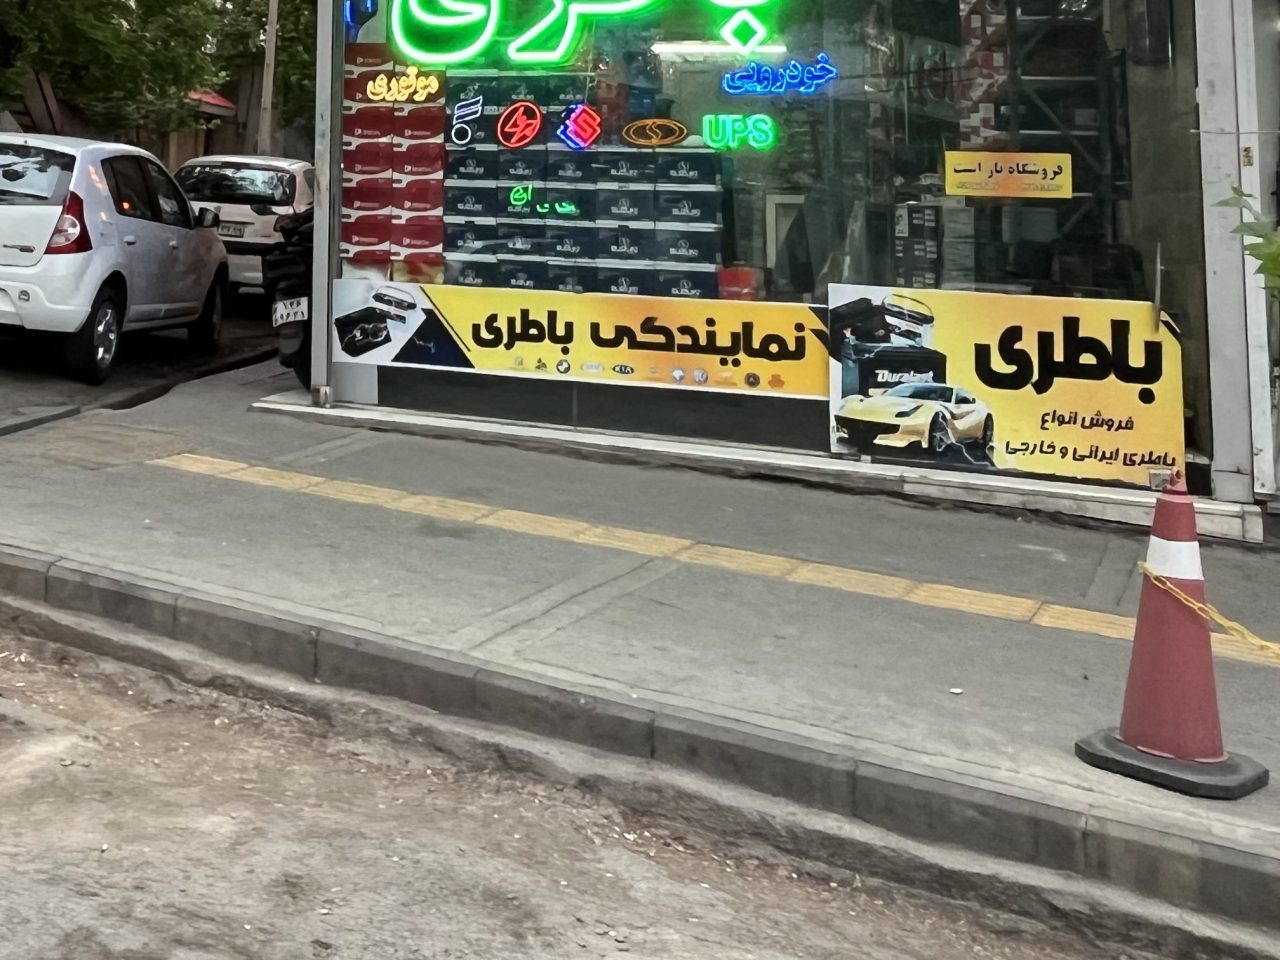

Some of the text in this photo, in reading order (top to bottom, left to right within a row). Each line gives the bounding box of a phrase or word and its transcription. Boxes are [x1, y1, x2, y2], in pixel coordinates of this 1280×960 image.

[703, 113, 774, 150] UPS
[471, 308, 574, 355] باطری
[974, 316, 1163, 404] باطری
[1040, 409, 1135, 431] فروش انواع
[1005, 440, 1057, 456] خارجی
[1072, 444, 1120, 465] ایرانی
